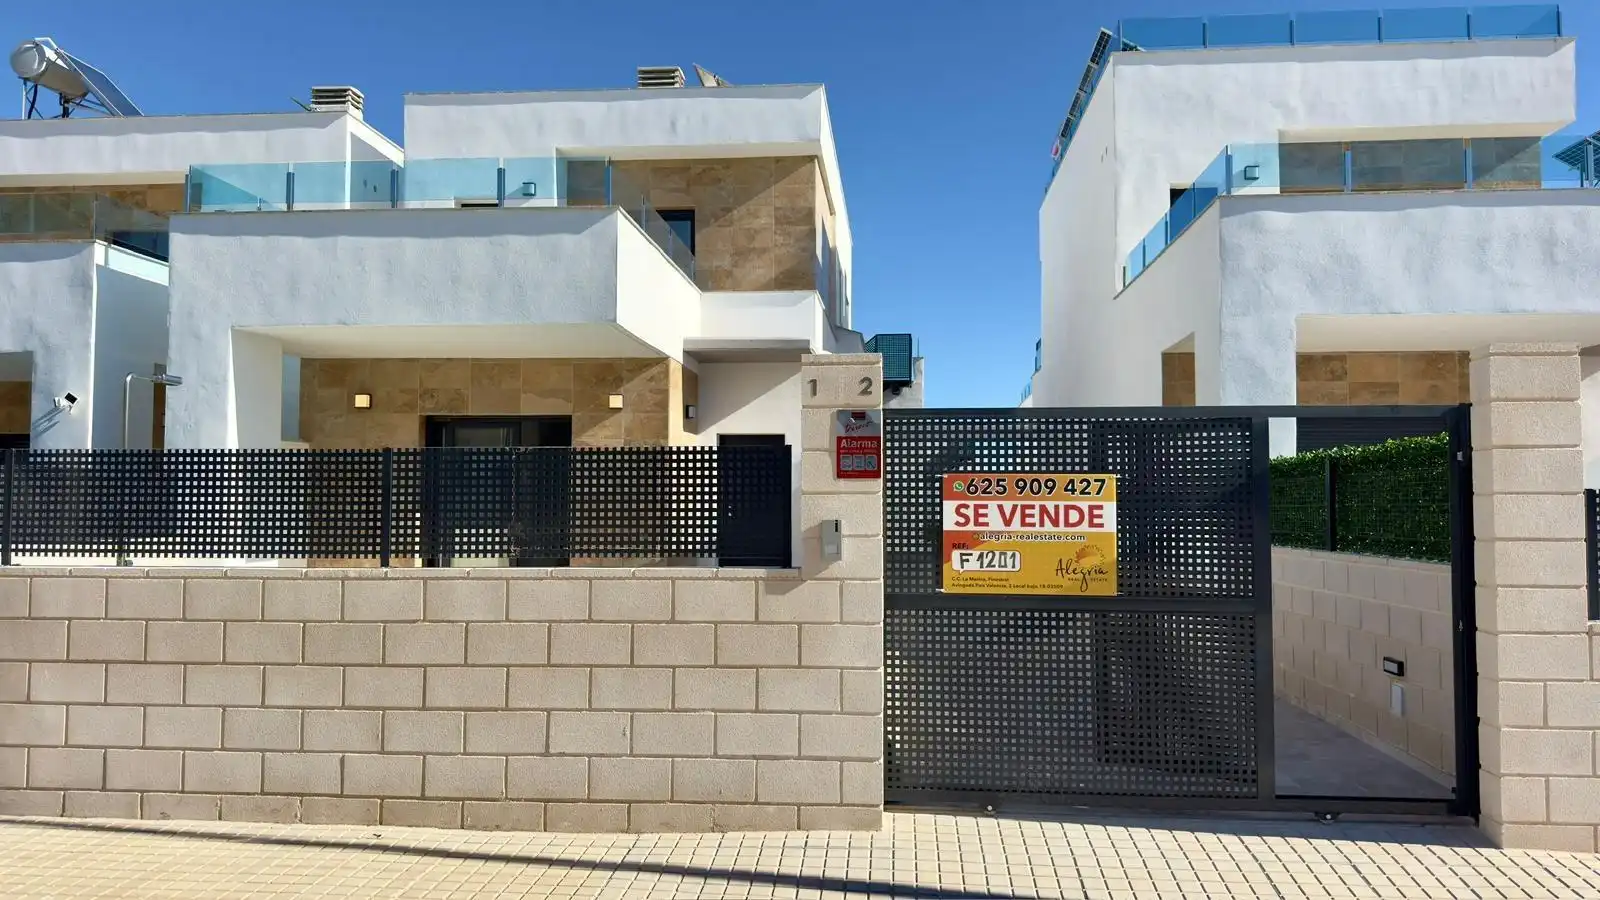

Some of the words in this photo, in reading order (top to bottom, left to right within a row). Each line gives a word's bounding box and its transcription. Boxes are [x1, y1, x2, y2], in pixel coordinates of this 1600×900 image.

[840, 438, 878, 449] Alarma
[966, 477, 1008, 496] 625
[1014, 477, 1057, 496] 909
[1063, 478, 1107, 497] 427
[954, 503, 989, 528] SE
[997, 503, 1105, 529] VENDE
